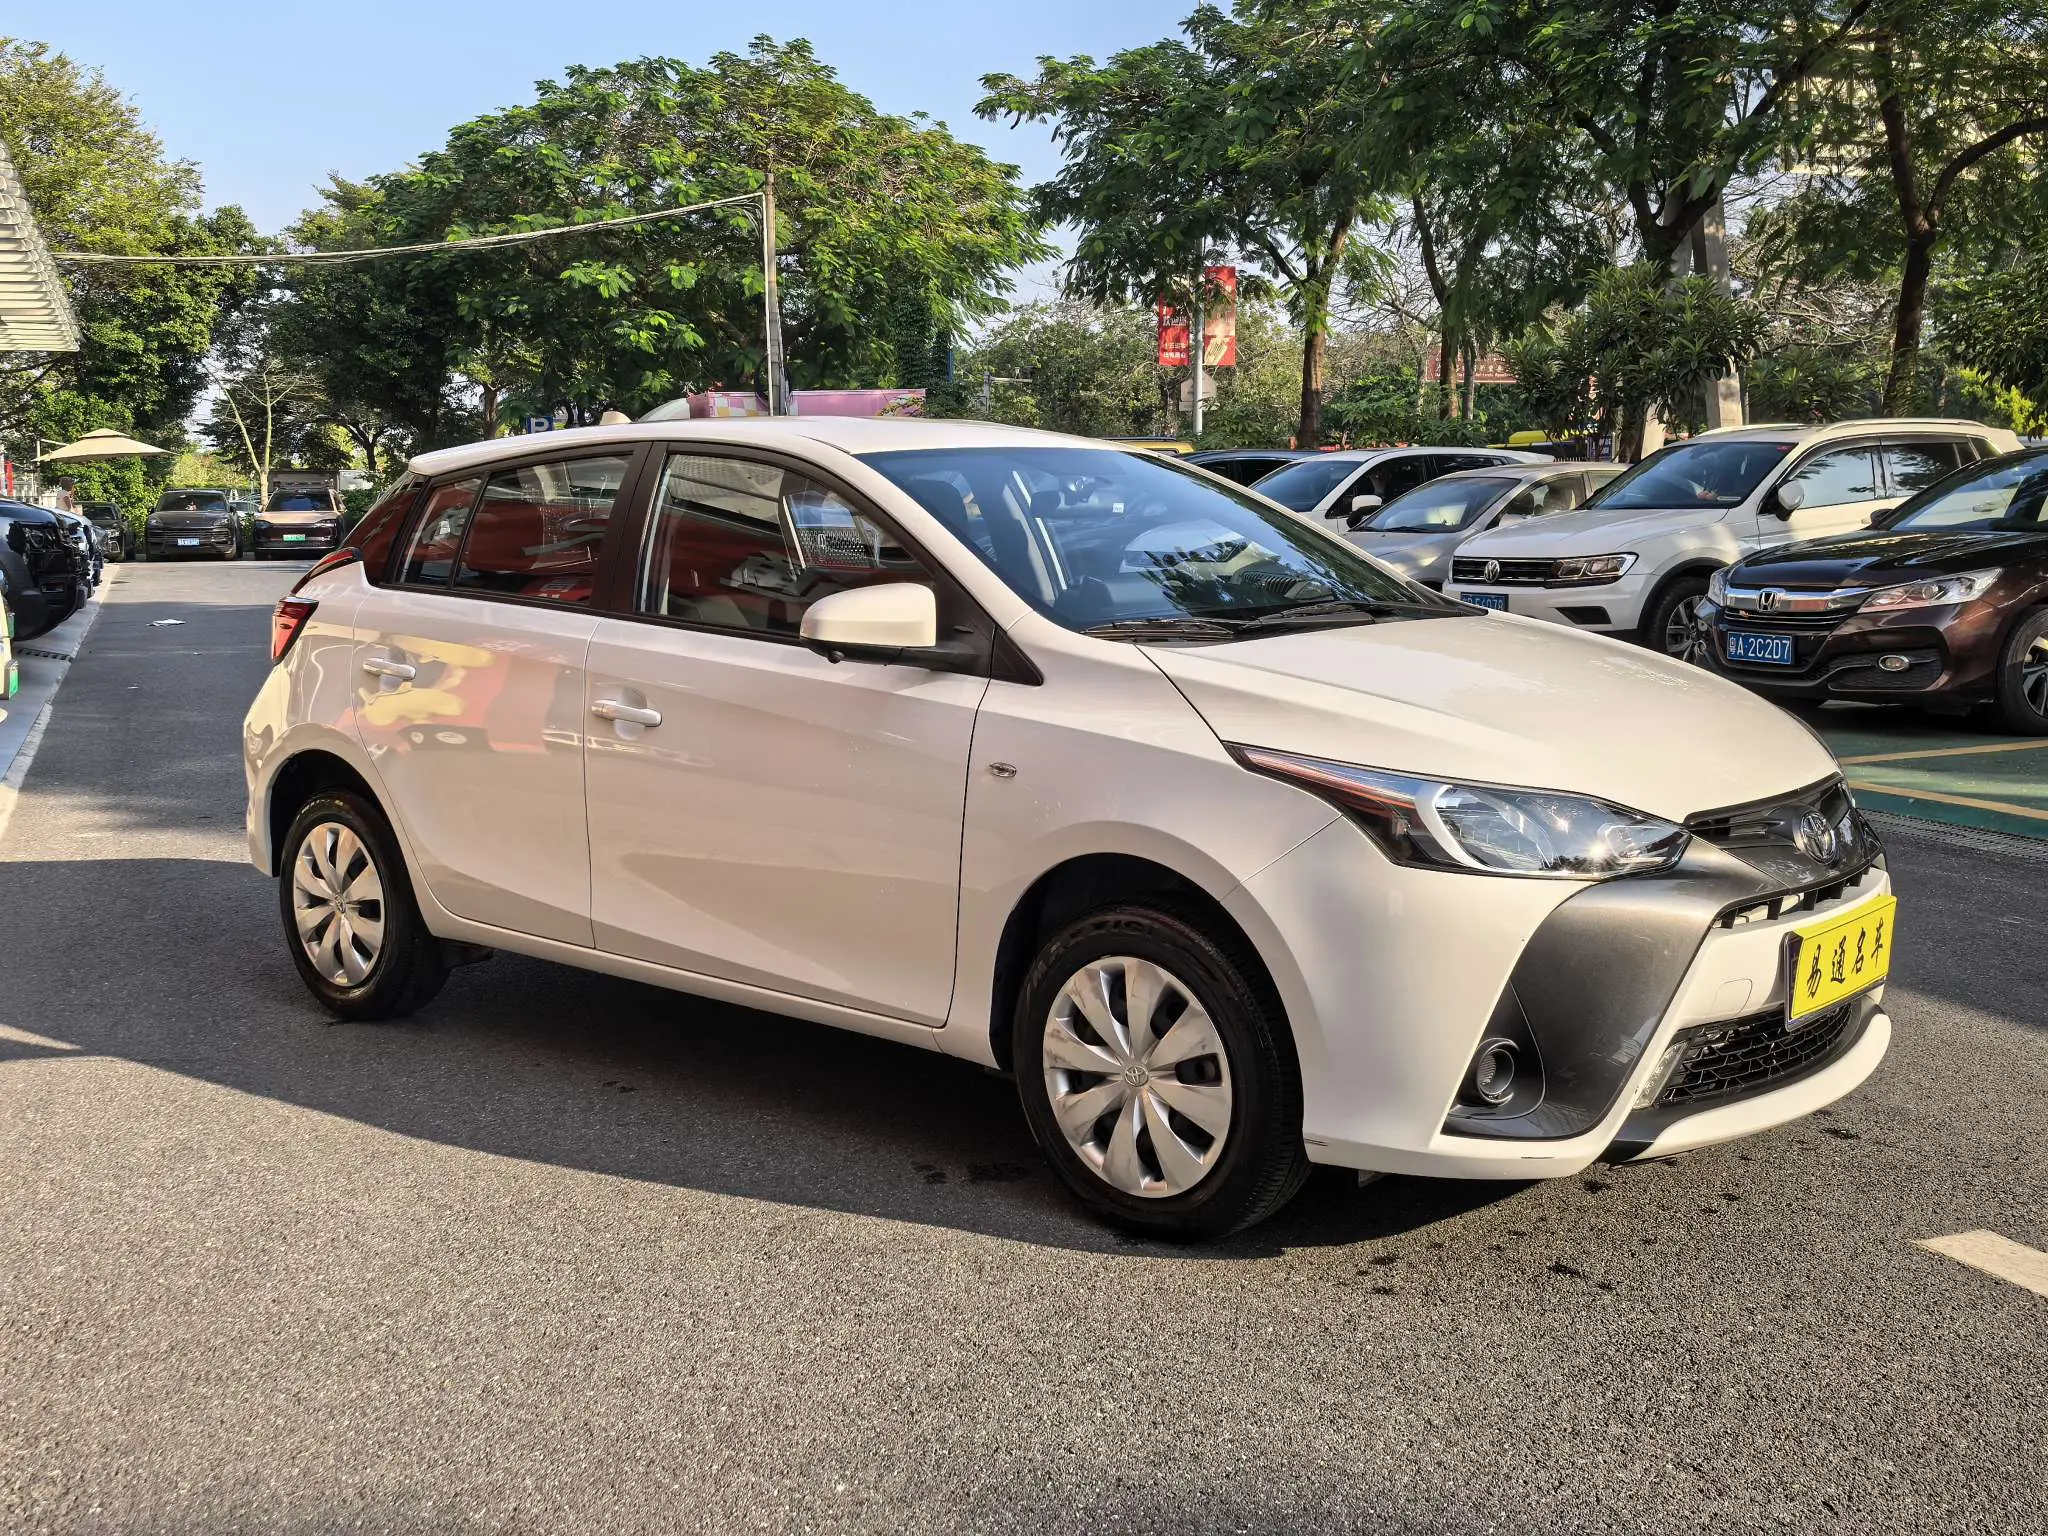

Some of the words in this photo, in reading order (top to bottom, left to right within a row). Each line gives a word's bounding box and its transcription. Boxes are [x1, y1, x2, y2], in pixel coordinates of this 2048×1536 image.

[530, 417, 549, 434] P
[1806, 915, 1885, 1000] 易通名车
